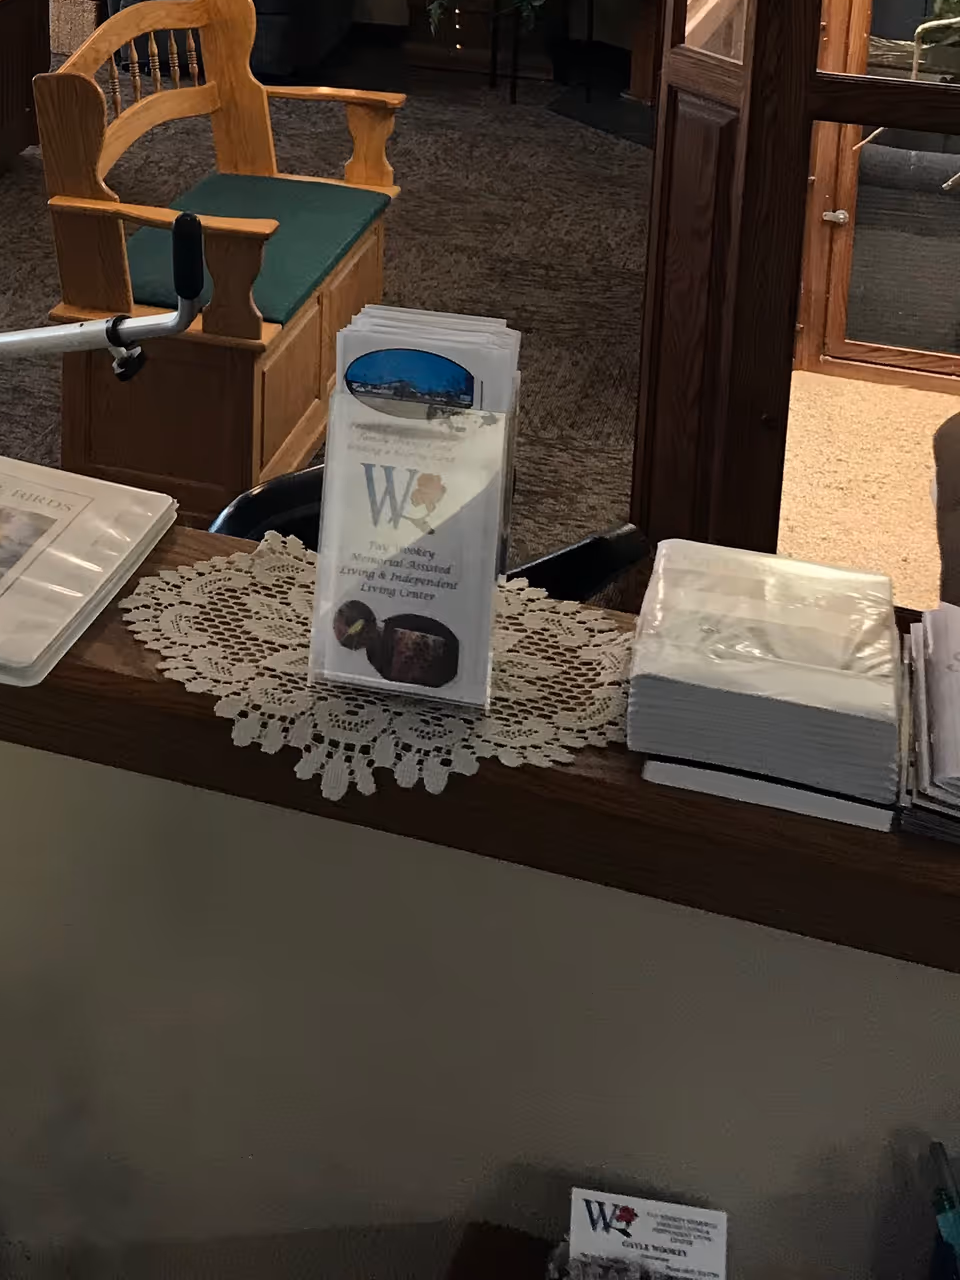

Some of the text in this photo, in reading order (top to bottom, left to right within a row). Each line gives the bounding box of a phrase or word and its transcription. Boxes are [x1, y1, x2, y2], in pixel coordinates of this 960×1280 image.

[10, 489, 75, 513] BIRDS
[351, 553, 453, 575] Memorial Assisted
[339, 566, 459, 590] Living & Independent
[360, 582, 437, 601] Living Center
